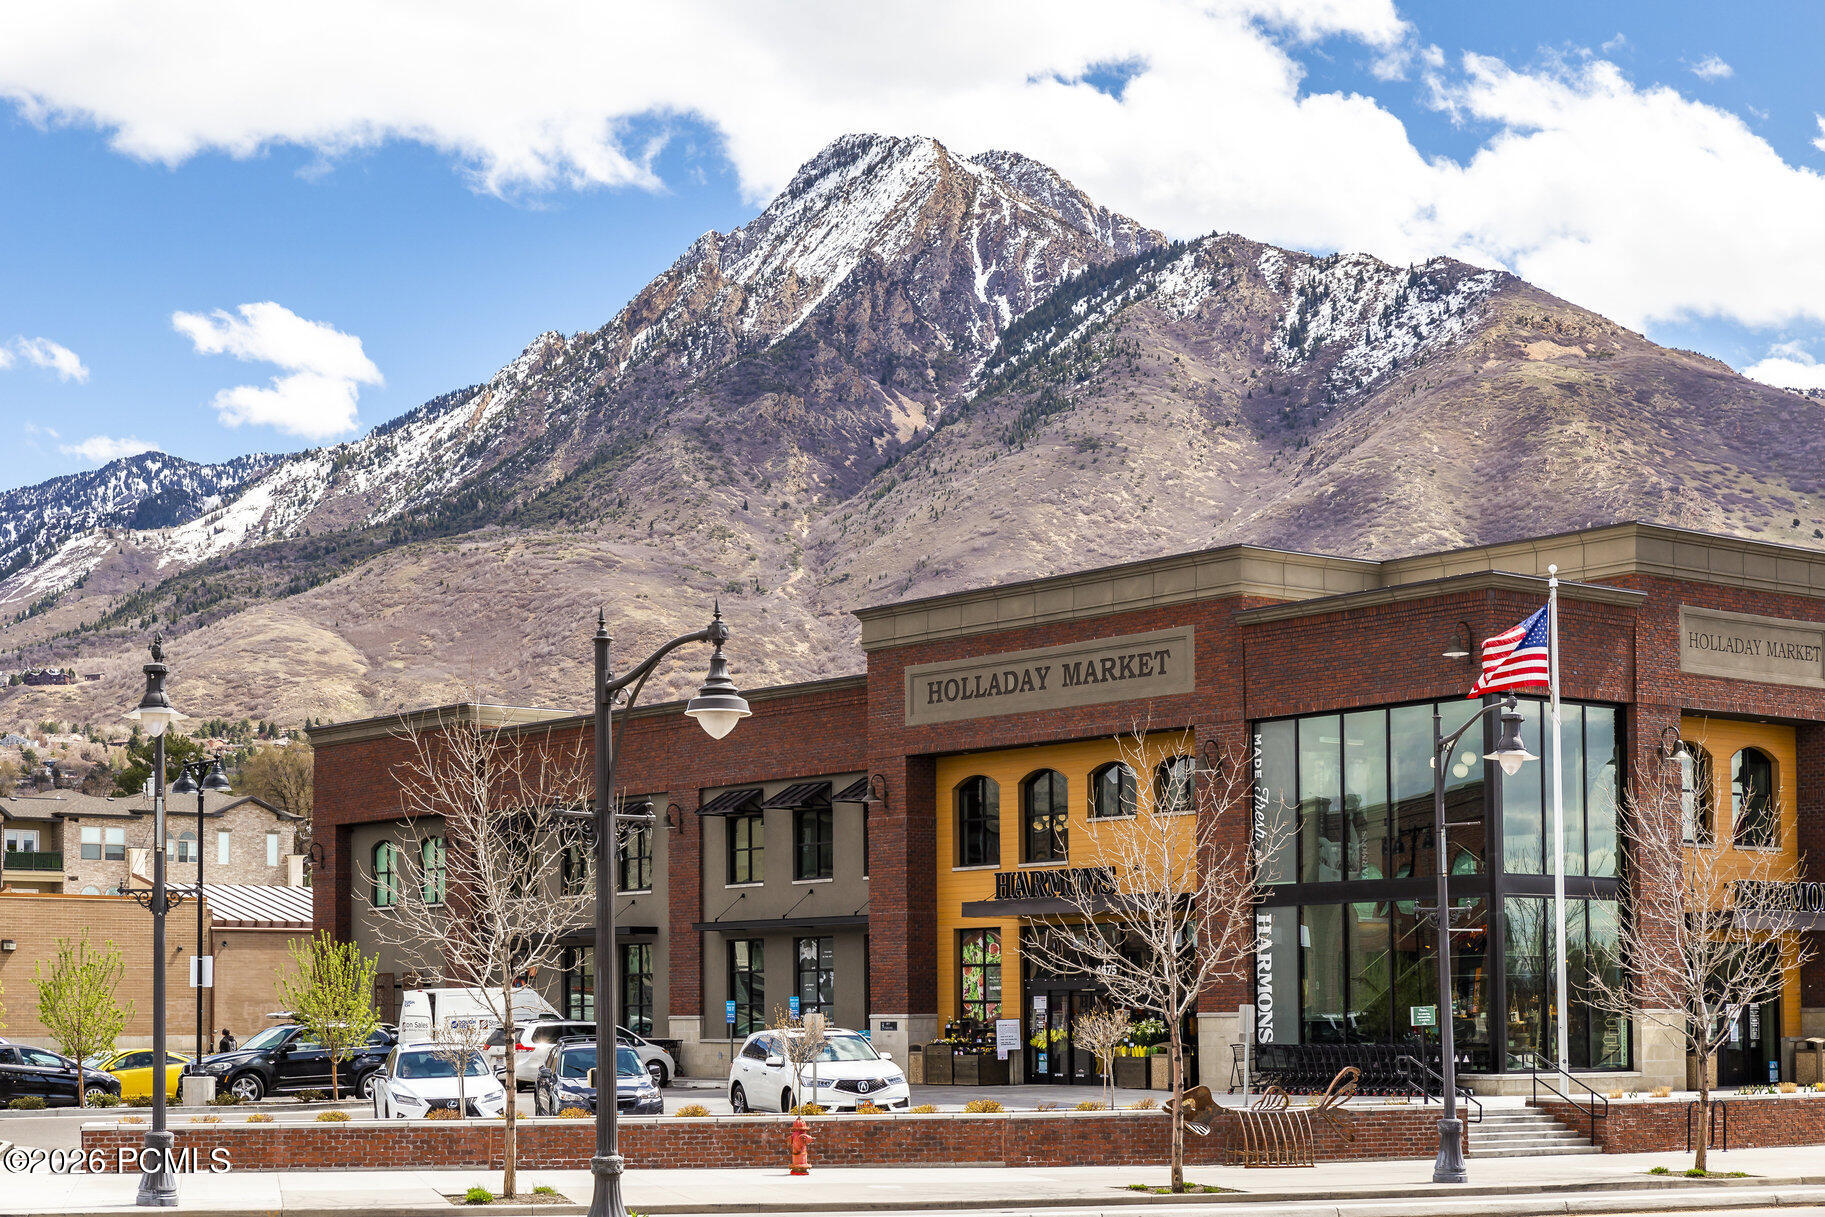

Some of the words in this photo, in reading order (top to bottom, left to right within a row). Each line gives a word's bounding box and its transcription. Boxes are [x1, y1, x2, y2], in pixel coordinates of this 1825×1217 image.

[1688, 631, 1761, 656] HOLLADAY
[1766, 640, 1822, 663] MARKET
[926, 665, 1051, 705] HOLLADAY
[1061, 648, 1172, 688] MARKET
[1253, 733, 1262, 780] MADE
[994, 865, 1118, 901] HARMONS
[1256, 913, 1274, 1044] HARMONS
